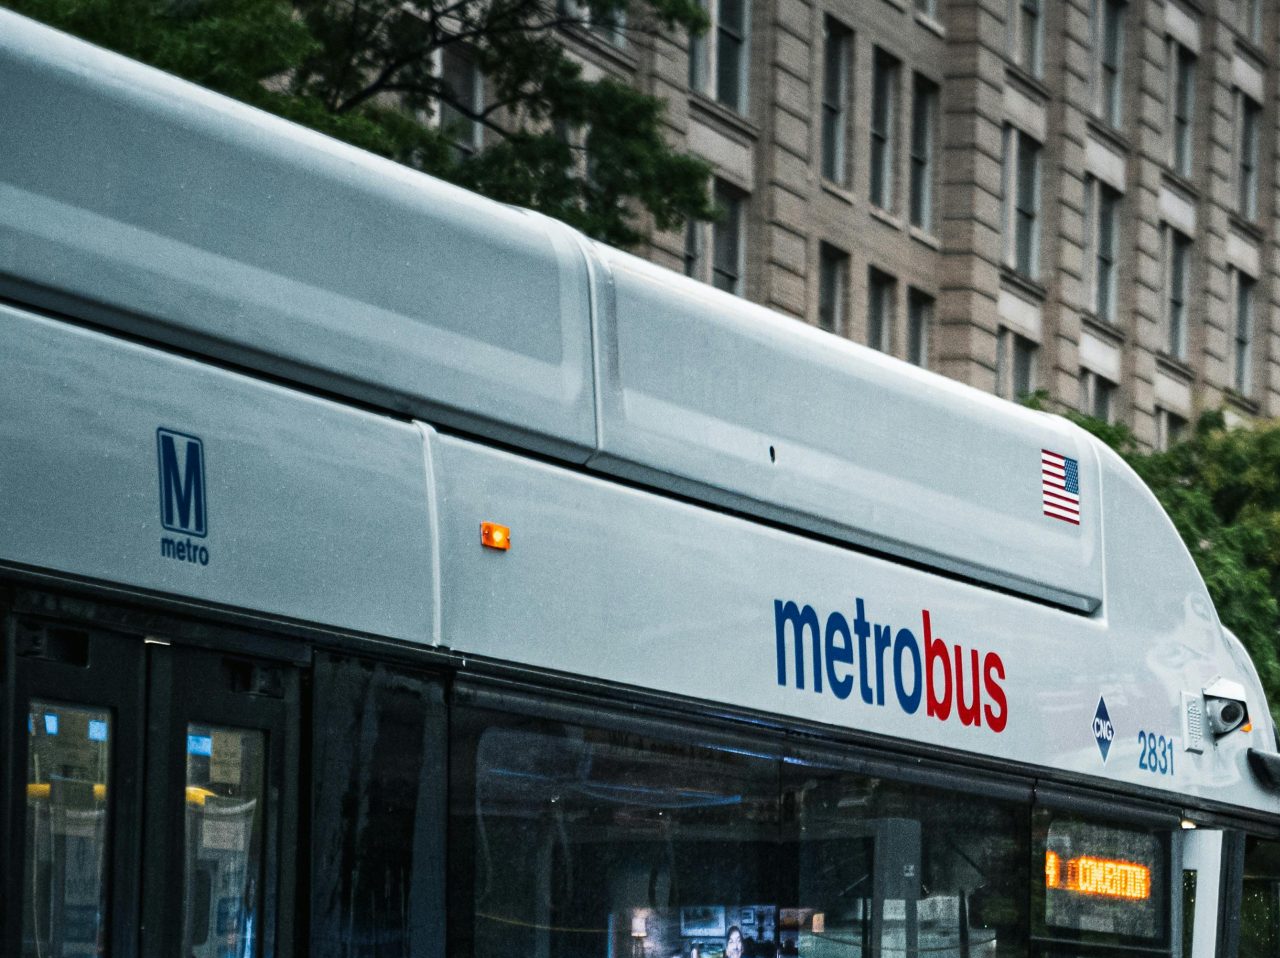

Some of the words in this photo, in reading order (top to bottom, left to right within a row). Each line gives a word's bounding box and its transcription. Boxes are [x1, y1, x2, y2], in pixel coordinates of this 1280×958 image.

[160, 537, 210, 567] metro
[773, 597, 1008, 733] metrobus
[1094, 717, 1114, 741] CNG
[1138, 730, 1174, 775] 2831
